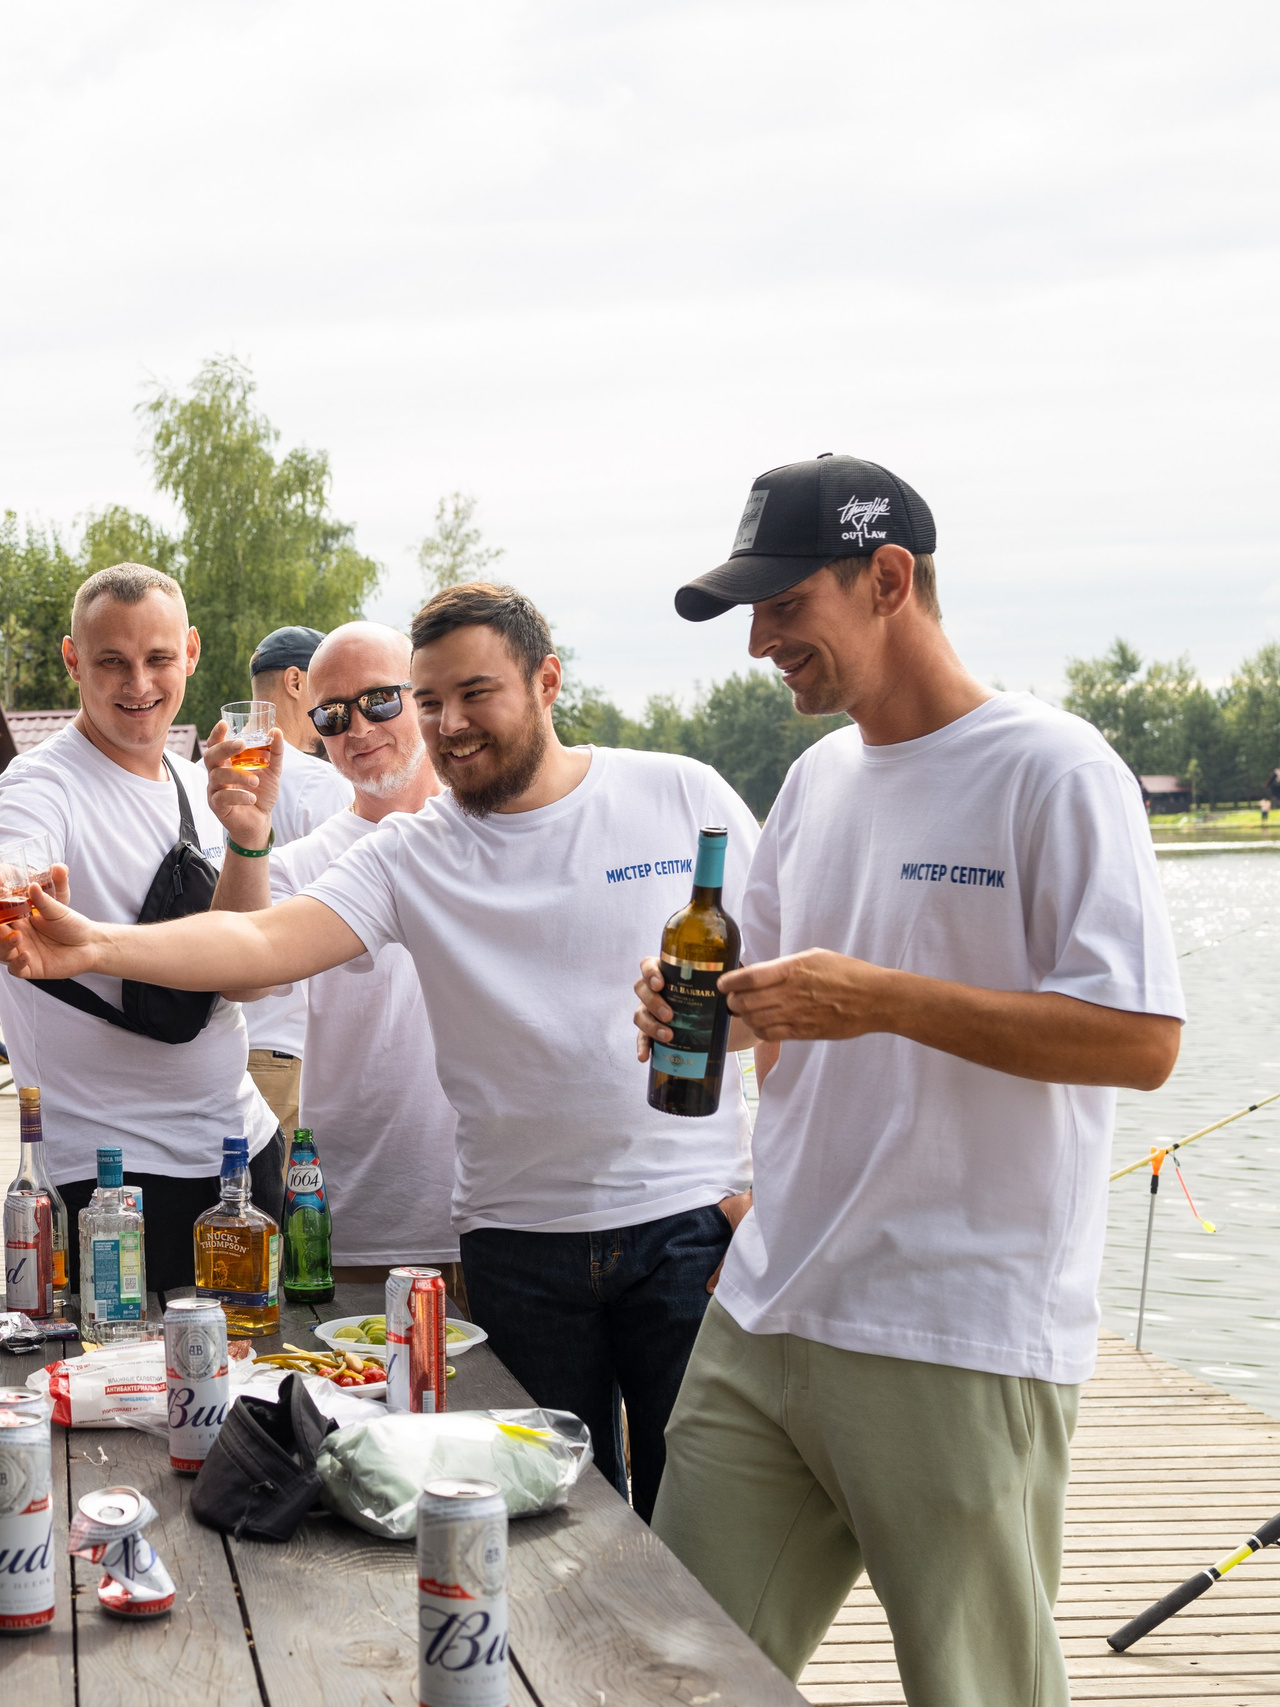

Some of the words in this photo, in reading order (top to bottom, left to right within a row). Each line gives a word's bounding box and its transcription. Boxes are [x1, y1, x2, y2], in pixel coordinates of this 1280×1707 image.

[842, 523, 887, 547] OUTLAW
[606, 863, 652, 884] МИСТЕР
[654, 859, 693, 876] СЕПТИК
[900, 863, 947, 882] МИСТЕР
[950, 865, 1006, 889] СЕПТИК
[679, 986, 716, 998] BARBARA
[289, 1170, 319, 1188] 1664
[200, 1240, 247, 1254] THOMPSON
[206, 1232, 241, 1244] NUCKY
